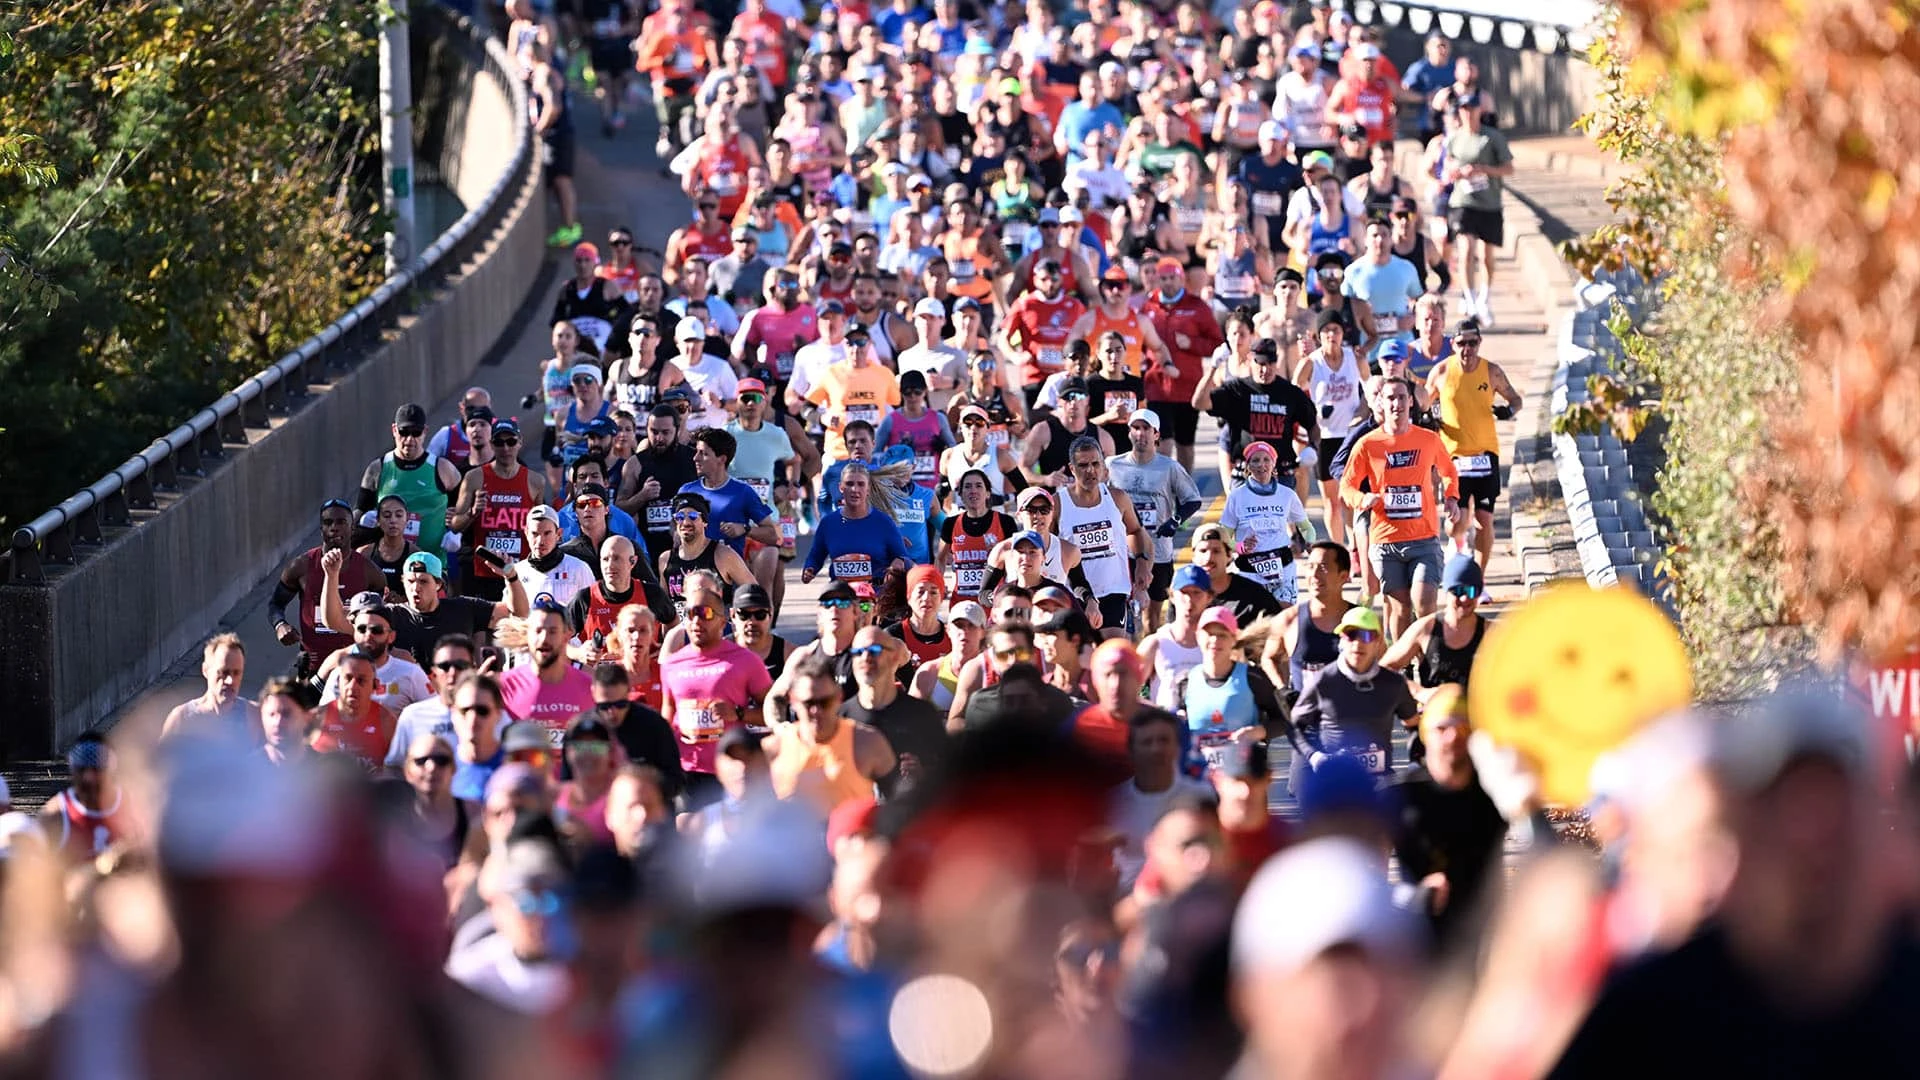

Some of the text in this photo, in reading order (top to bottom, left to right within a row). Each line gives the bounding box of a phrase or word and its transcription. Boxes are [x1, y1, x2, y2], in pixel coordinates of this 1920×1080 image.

[848, 391, 875, 400] JAMES
[1250, 403, 1287, 415] THEM HOME
[491, 494, 522, 503] ESSEX
[1391, 494, 1416, 505] 7864
[1246, 504, 1284, 513] TEAM TCS
[1079, 530, 1109, 545] 3968
[489, 539, 515, 550] 7867
[836, 562, 869, 573] 55278
[531, 704, 580, 712] PELOTON
